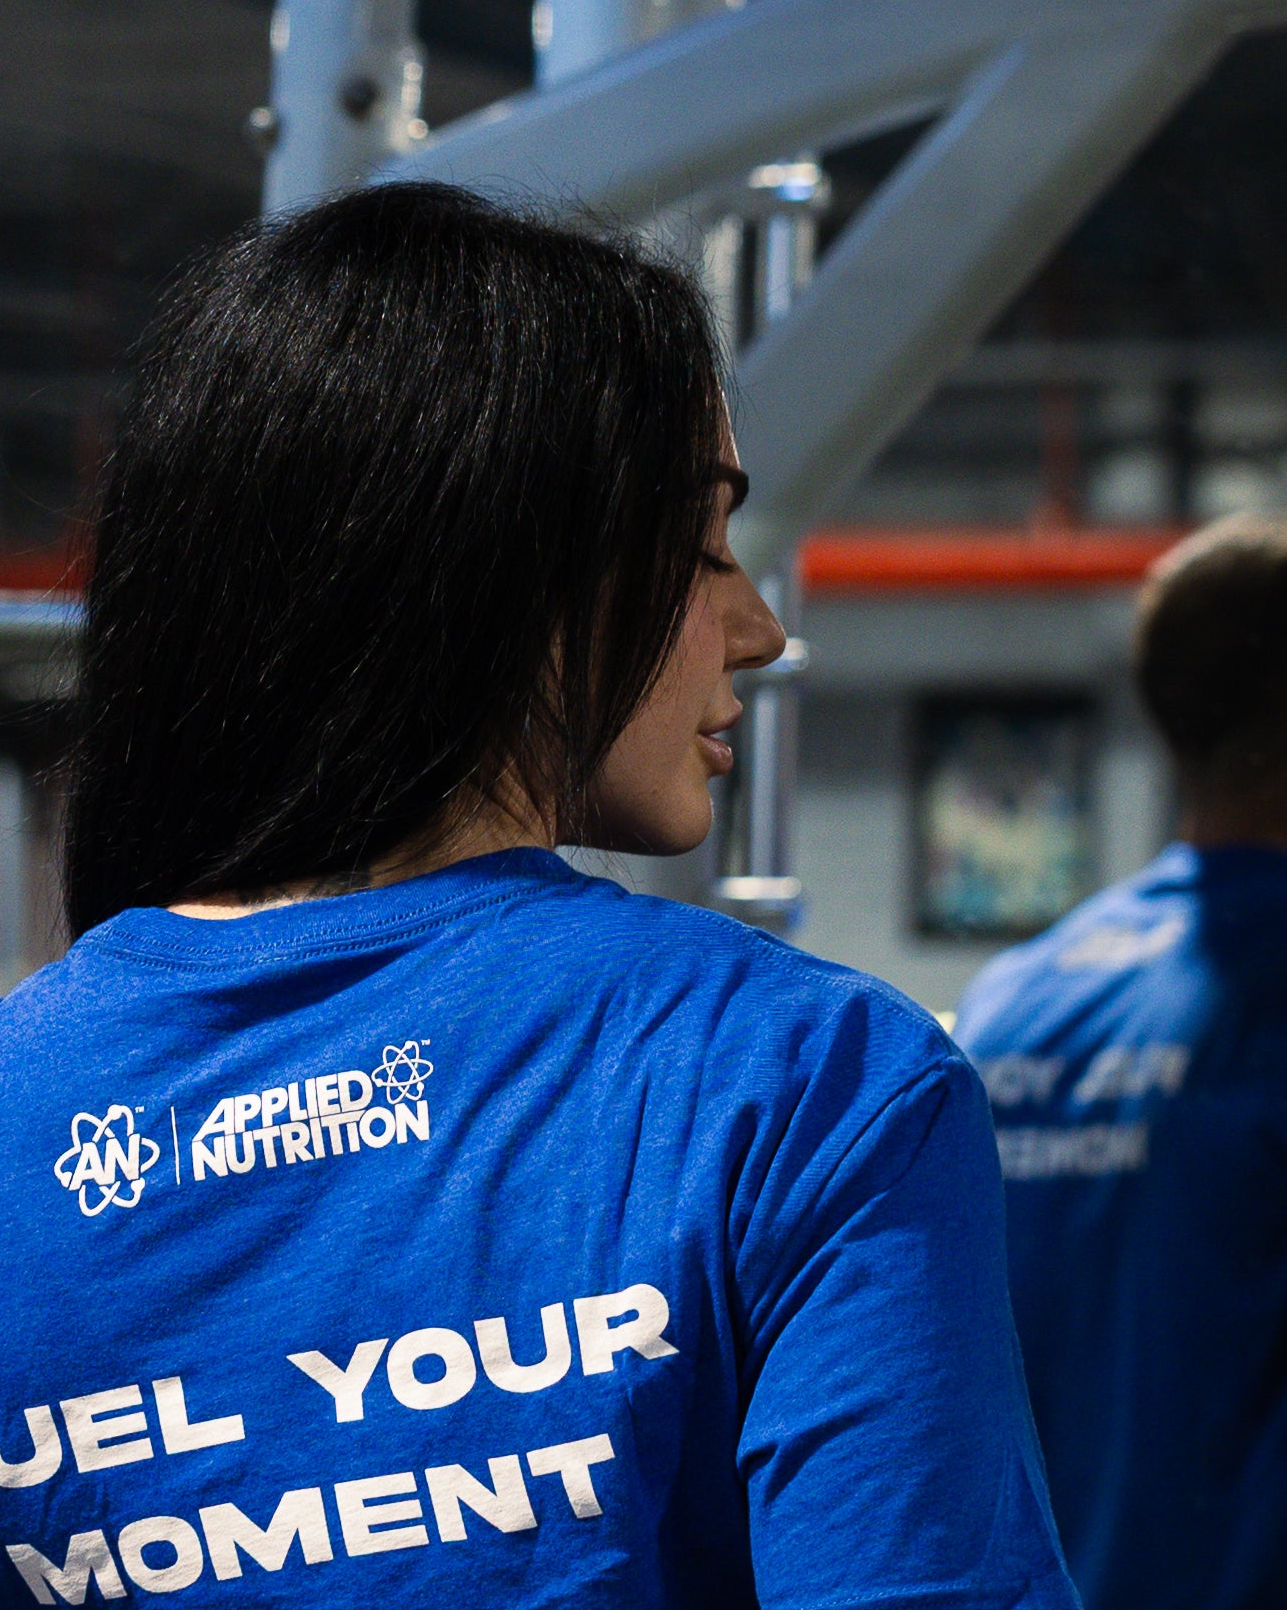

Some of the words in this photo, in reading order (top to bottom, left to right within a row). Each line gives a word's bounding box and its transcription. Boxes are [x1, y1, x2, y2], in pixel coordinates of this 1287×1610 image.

[191, 1099, 430, 1181] NUTRITION
[192, 1070, 373, 1143] APPLIED
[67, 1133, 140, 1191] AN
[286, 1283, 680, 1424] YOUR
[5, 1433, 616, 1605] MOMENT
